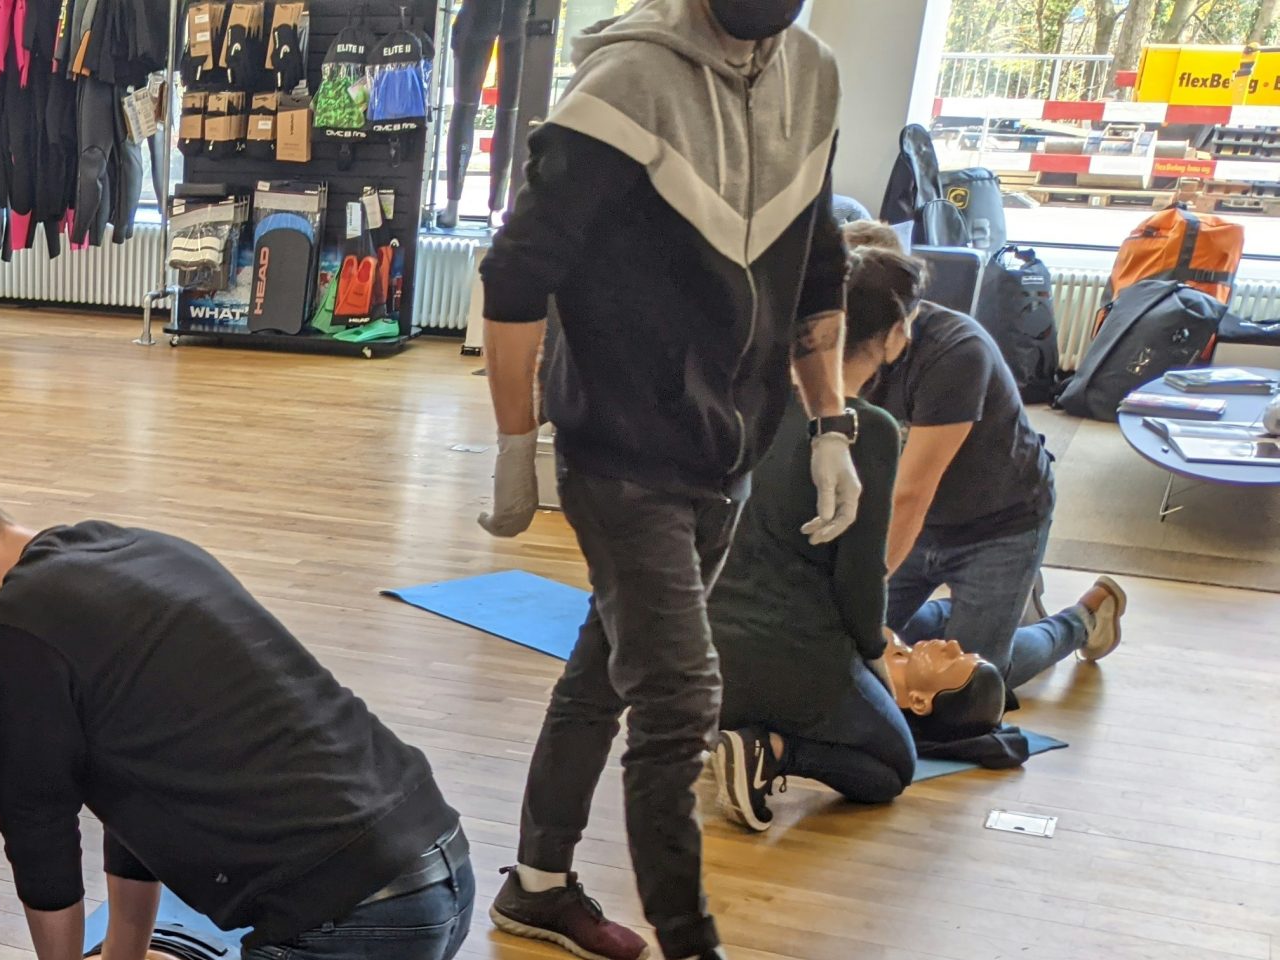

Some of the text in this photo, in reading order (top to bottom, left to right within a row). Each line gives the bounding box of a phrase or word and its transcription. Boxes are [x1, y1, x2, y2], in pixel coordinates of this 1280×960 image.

[337, 44, 357, 53] ELITE
[383, 45, 404, 56] ELITE
[1178, 72, 1259, 94] flexBeg
[254, 246, 270, 315] HEAD
